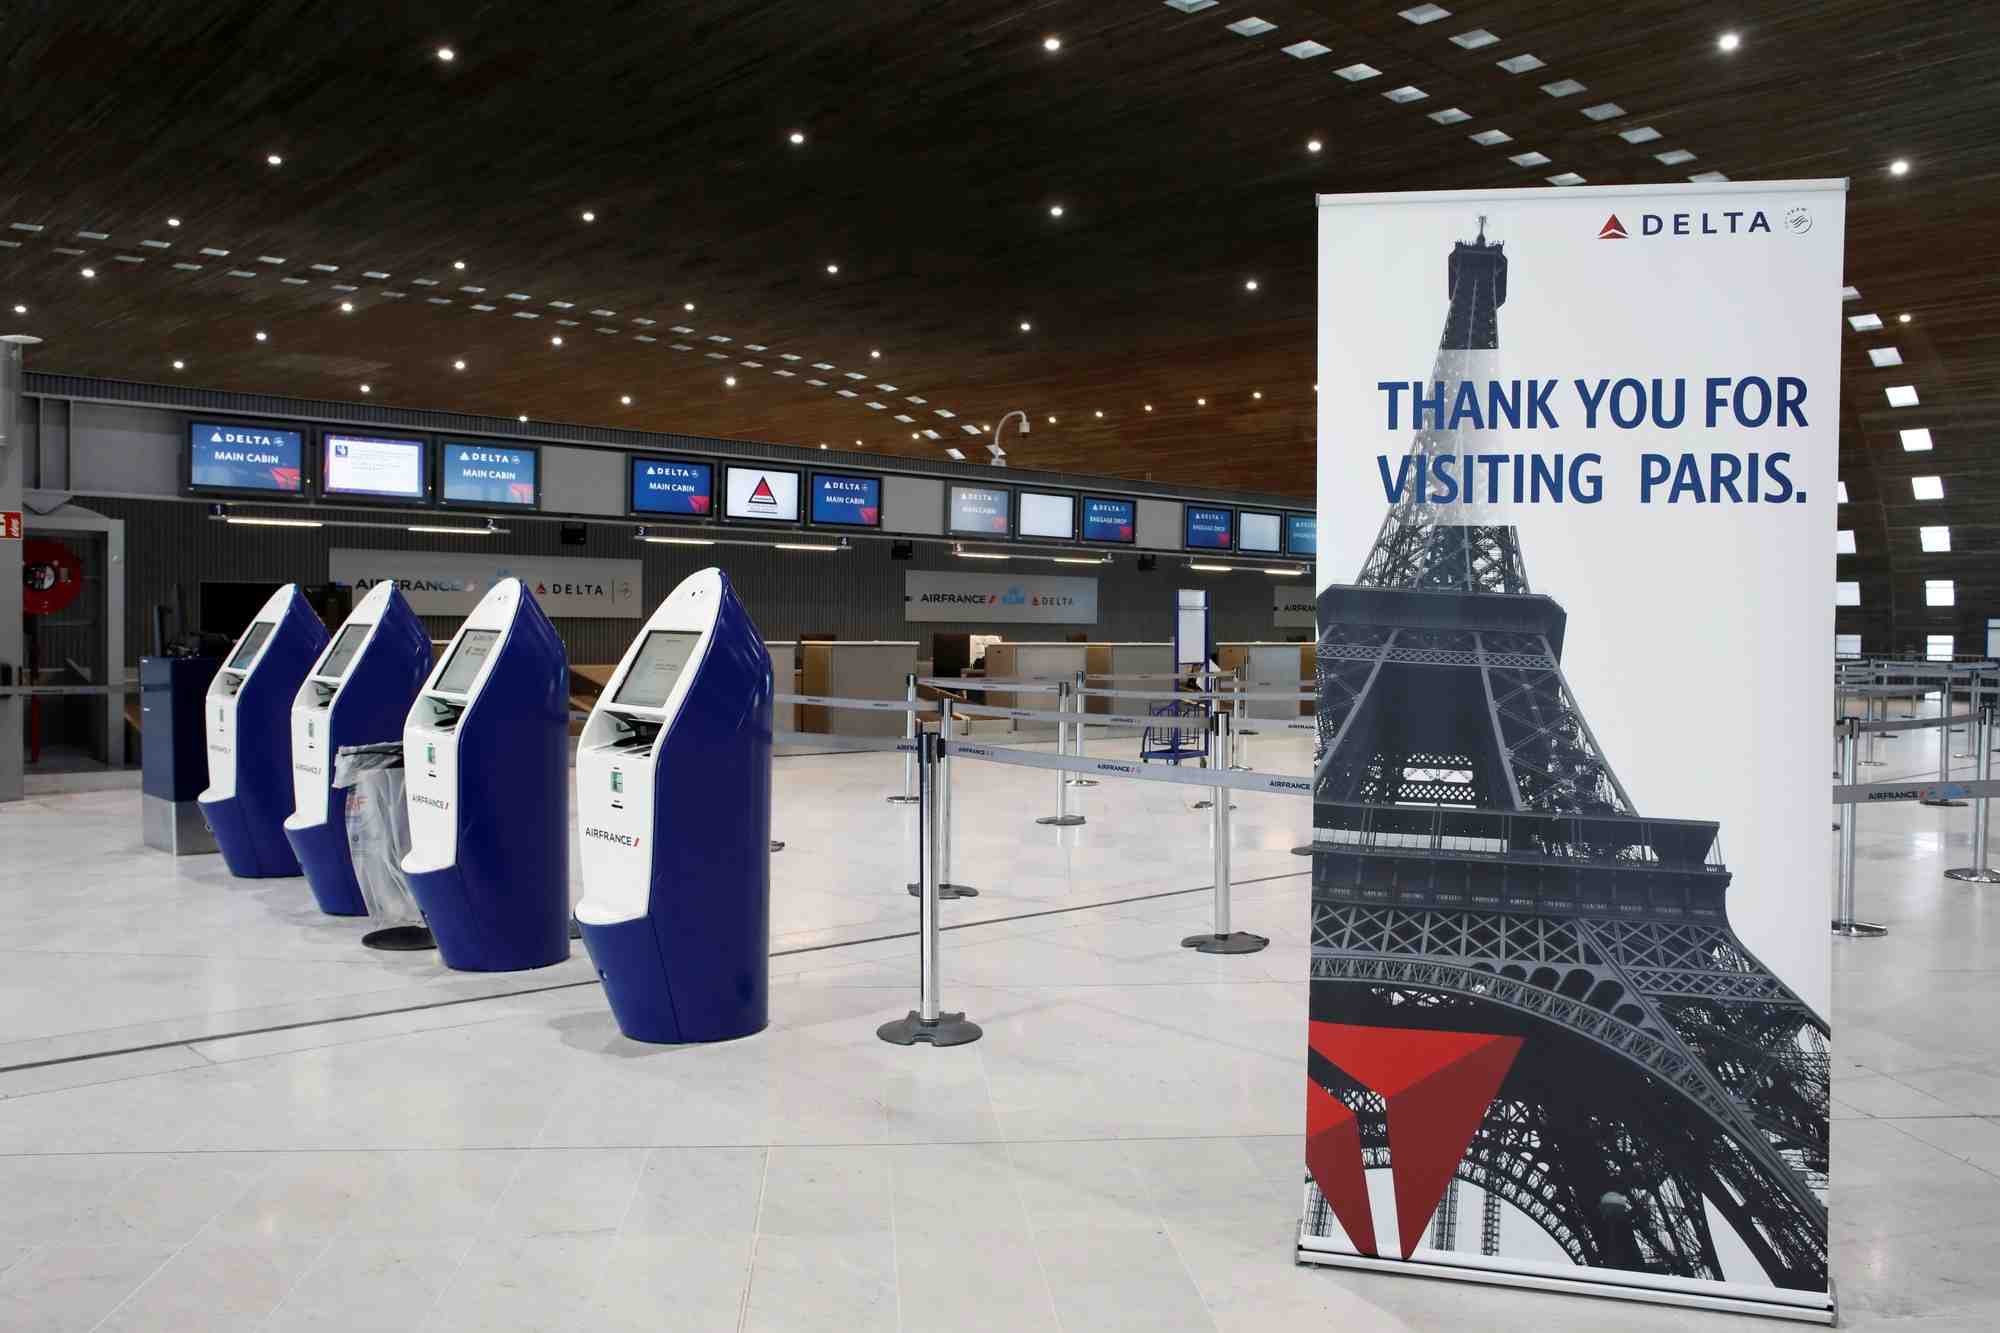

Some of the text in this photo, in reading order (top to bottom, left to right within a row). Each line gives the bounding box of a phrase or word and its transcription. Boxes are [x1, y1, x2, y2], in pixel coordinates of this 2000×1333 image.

[1642, 210, 1772, 236] DELTA
[1377, 375, 1809, 431] THANK YOU FOR
[225, 433, 271, 446] DELTA
[213, 451, 280, 465] MAIN CABIN
[471, 452, 510, 463] DELTA
[462, 468, 517, 481] MAIN CABIN
[656, 466, 690, 477] DELTA
[1376, 451, 1808, 504] VISITING PARIS.
[648, 481, 696, 493] MAIN CABIN
[832, 480, 861, 491] DELTA
[825, 494, 865, 506] MAIN CABIN
[215, 504, 222, 515] 1
[1099, 503, 1120, 512] DELTA
[487, 519, 494, 529] 2
[638, 526, 645, 536] 3
[840, 536, 848, 546] 4
[355, 578, 462, 592] AIRANCE
[551, 583, 604, 596] DELTA
[920, 592, 987, 605] AIRFRANCE
[1041, 596, 1073, 607] DELTA
[1097, 763, 1131, 774] AIRFRANCE
[1268, 780, 1312, 791] AIRFRANCE
[1868, 790, 1920, 801] AIRFRANCE
[585, 826, 633, 847] AIRFRANCE
